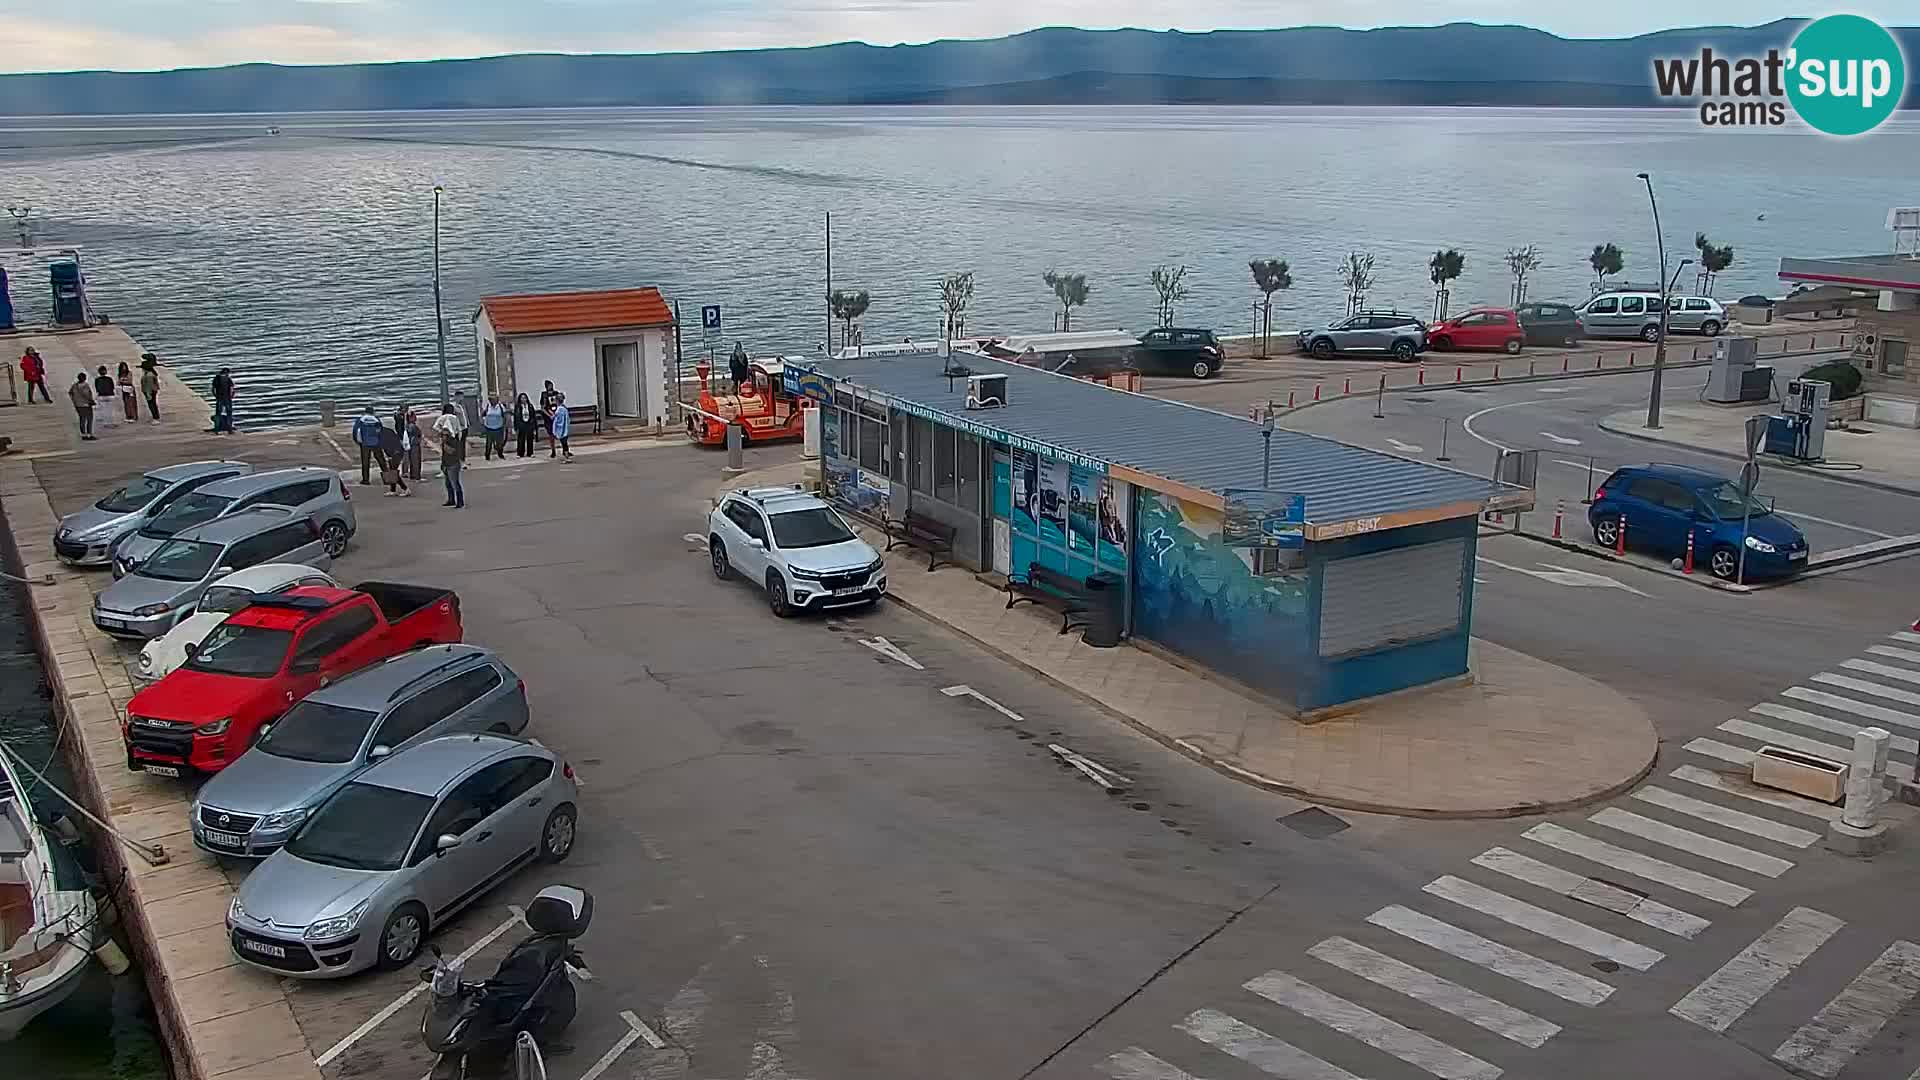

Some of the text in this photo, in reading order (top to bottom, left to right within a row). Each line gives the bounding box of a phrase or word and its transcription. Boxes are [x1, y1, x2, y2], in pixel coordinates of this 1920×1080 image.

[706, 308, 717, 325] P
[933, 411, 969, 431] AUTOBUSNA
[970, 422, 999, 440] POSTAJA
[1007, 434, 1021, 447] BUS
[1022, 439, 1053, 457] STATION
[1054, 448, 1079, 465] TICKET
[1079, 456, 1105, 473] OFFICE
[147, 718, 172, 729] ISUZU
